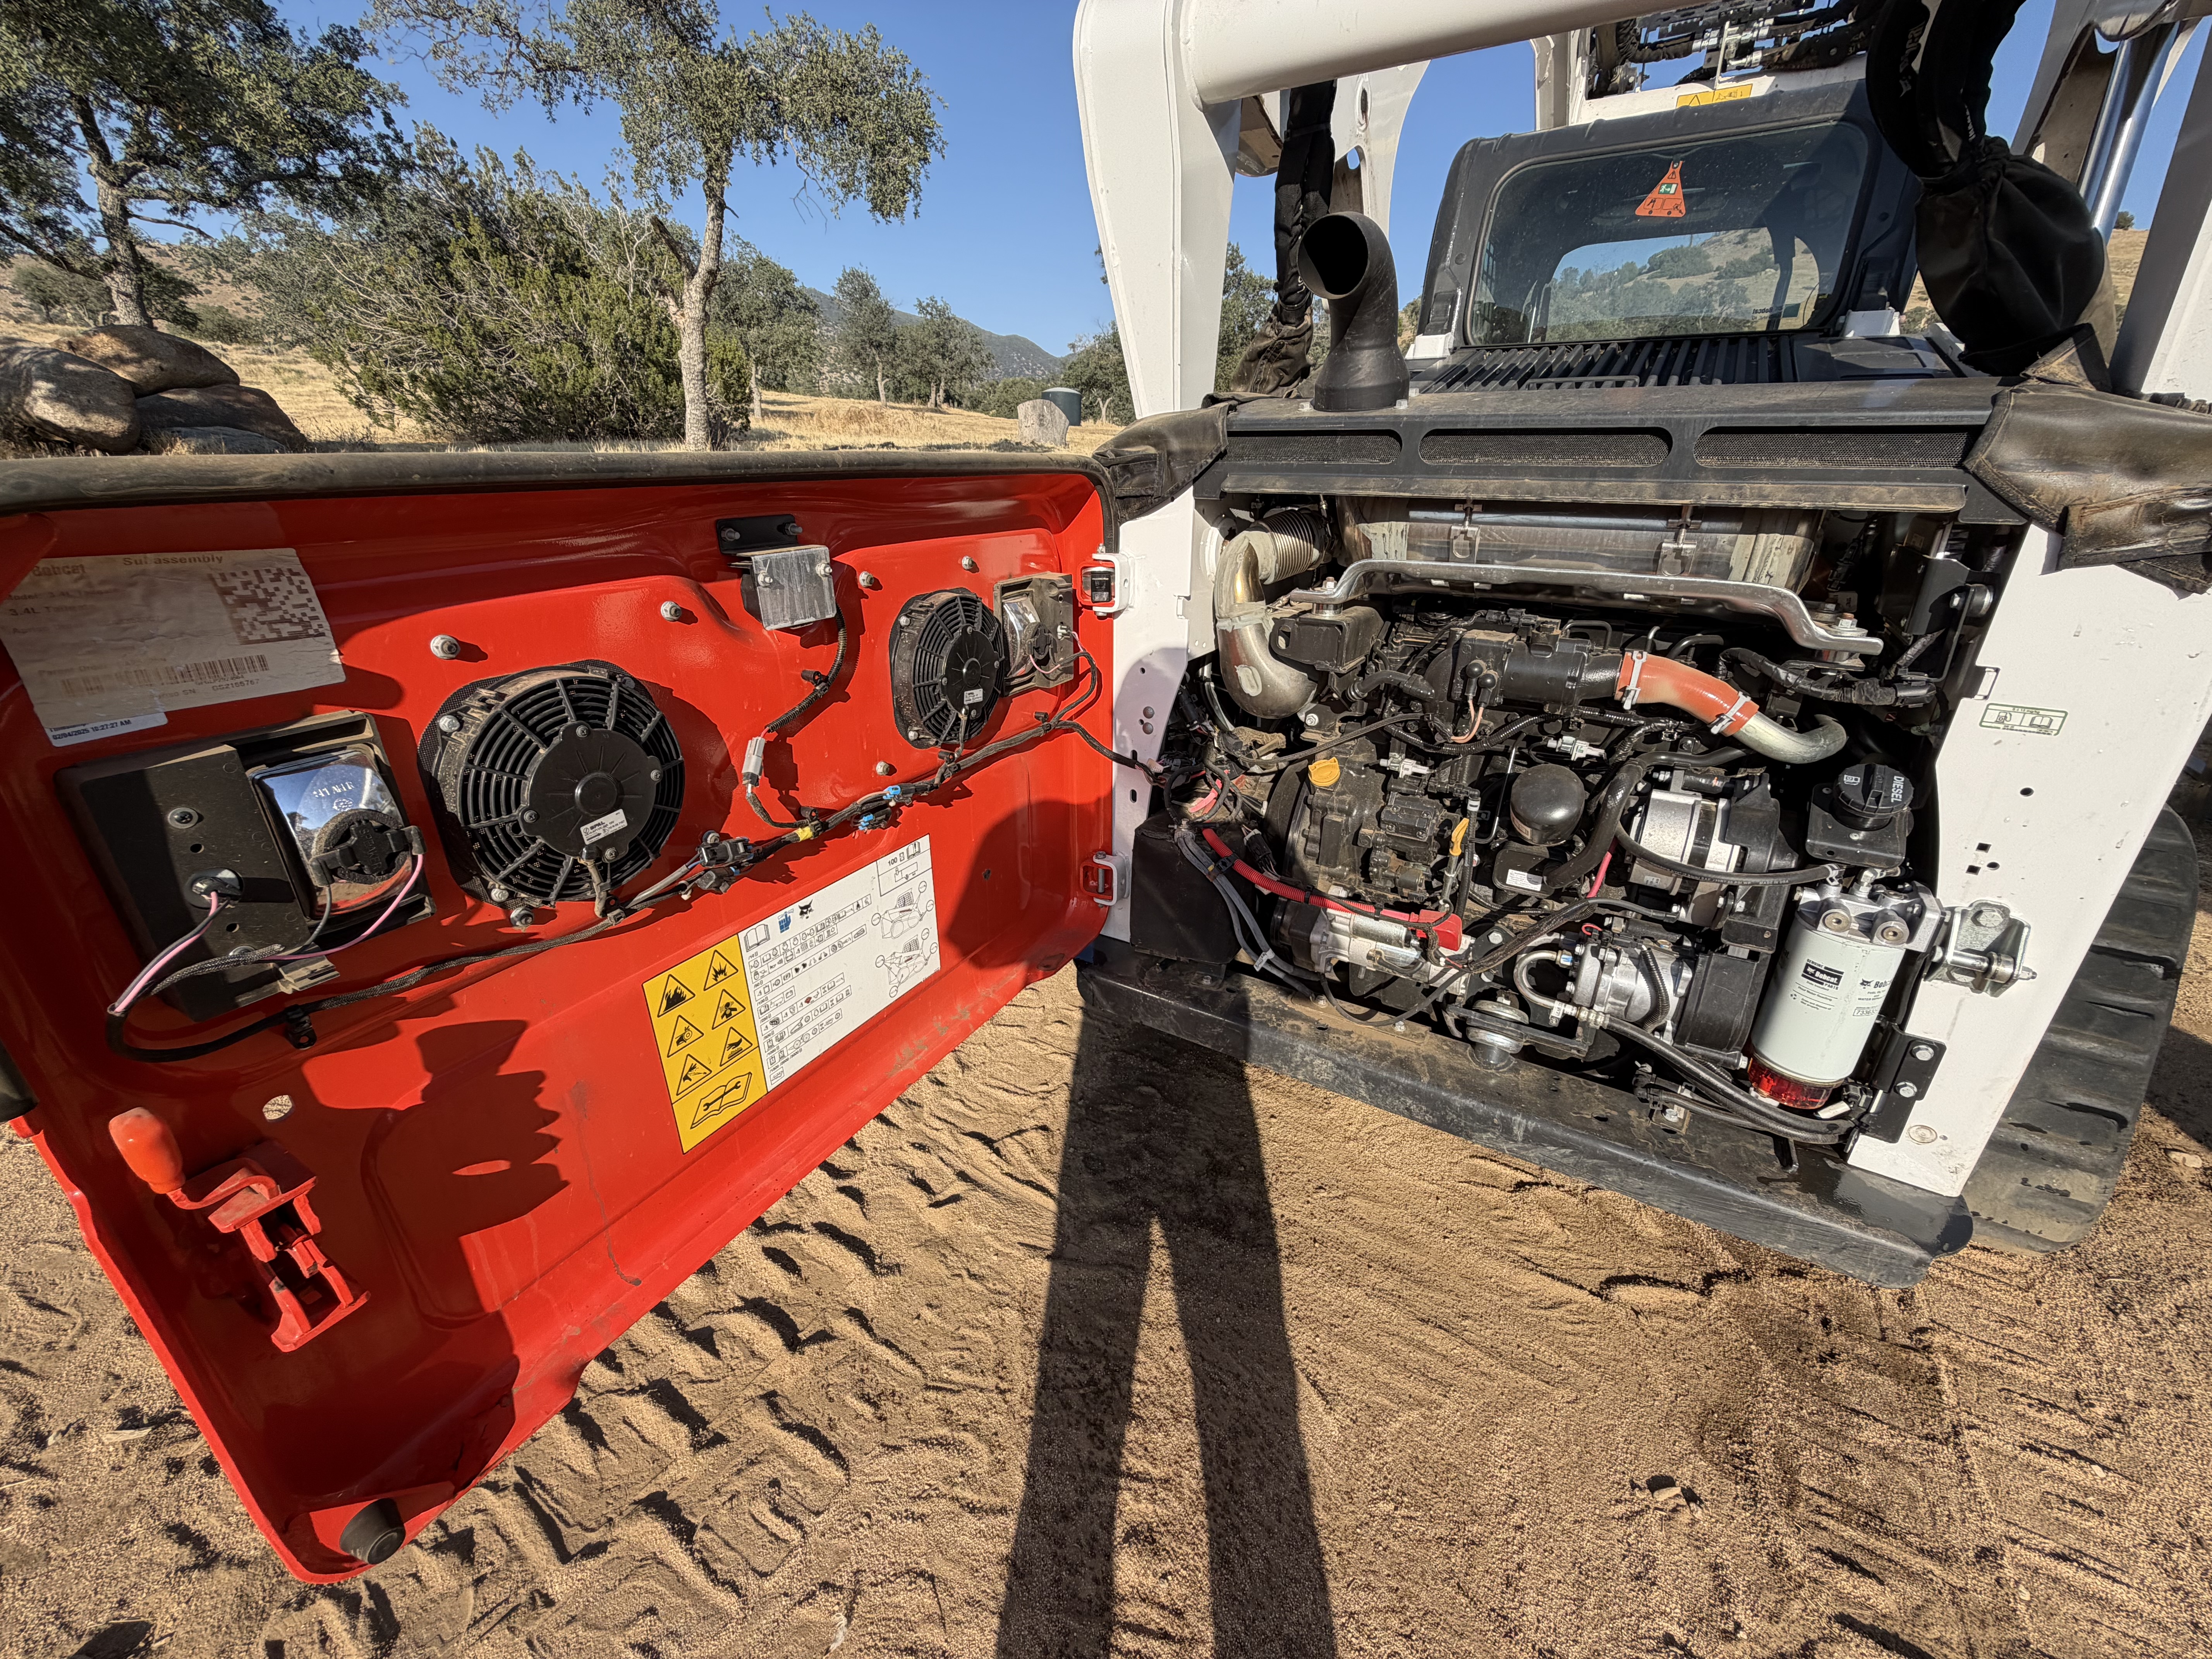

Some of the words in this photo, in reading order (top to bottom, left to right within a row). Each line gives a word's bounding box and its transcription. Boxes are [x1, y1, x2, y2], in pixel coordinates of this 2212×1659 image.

[1891, 776, 1905, 802] DIESEL
[590, 821, 605, 830] SPAL
[359, 829, 382, 870] SPEAKER
[888, 857, 898, 866] 100
